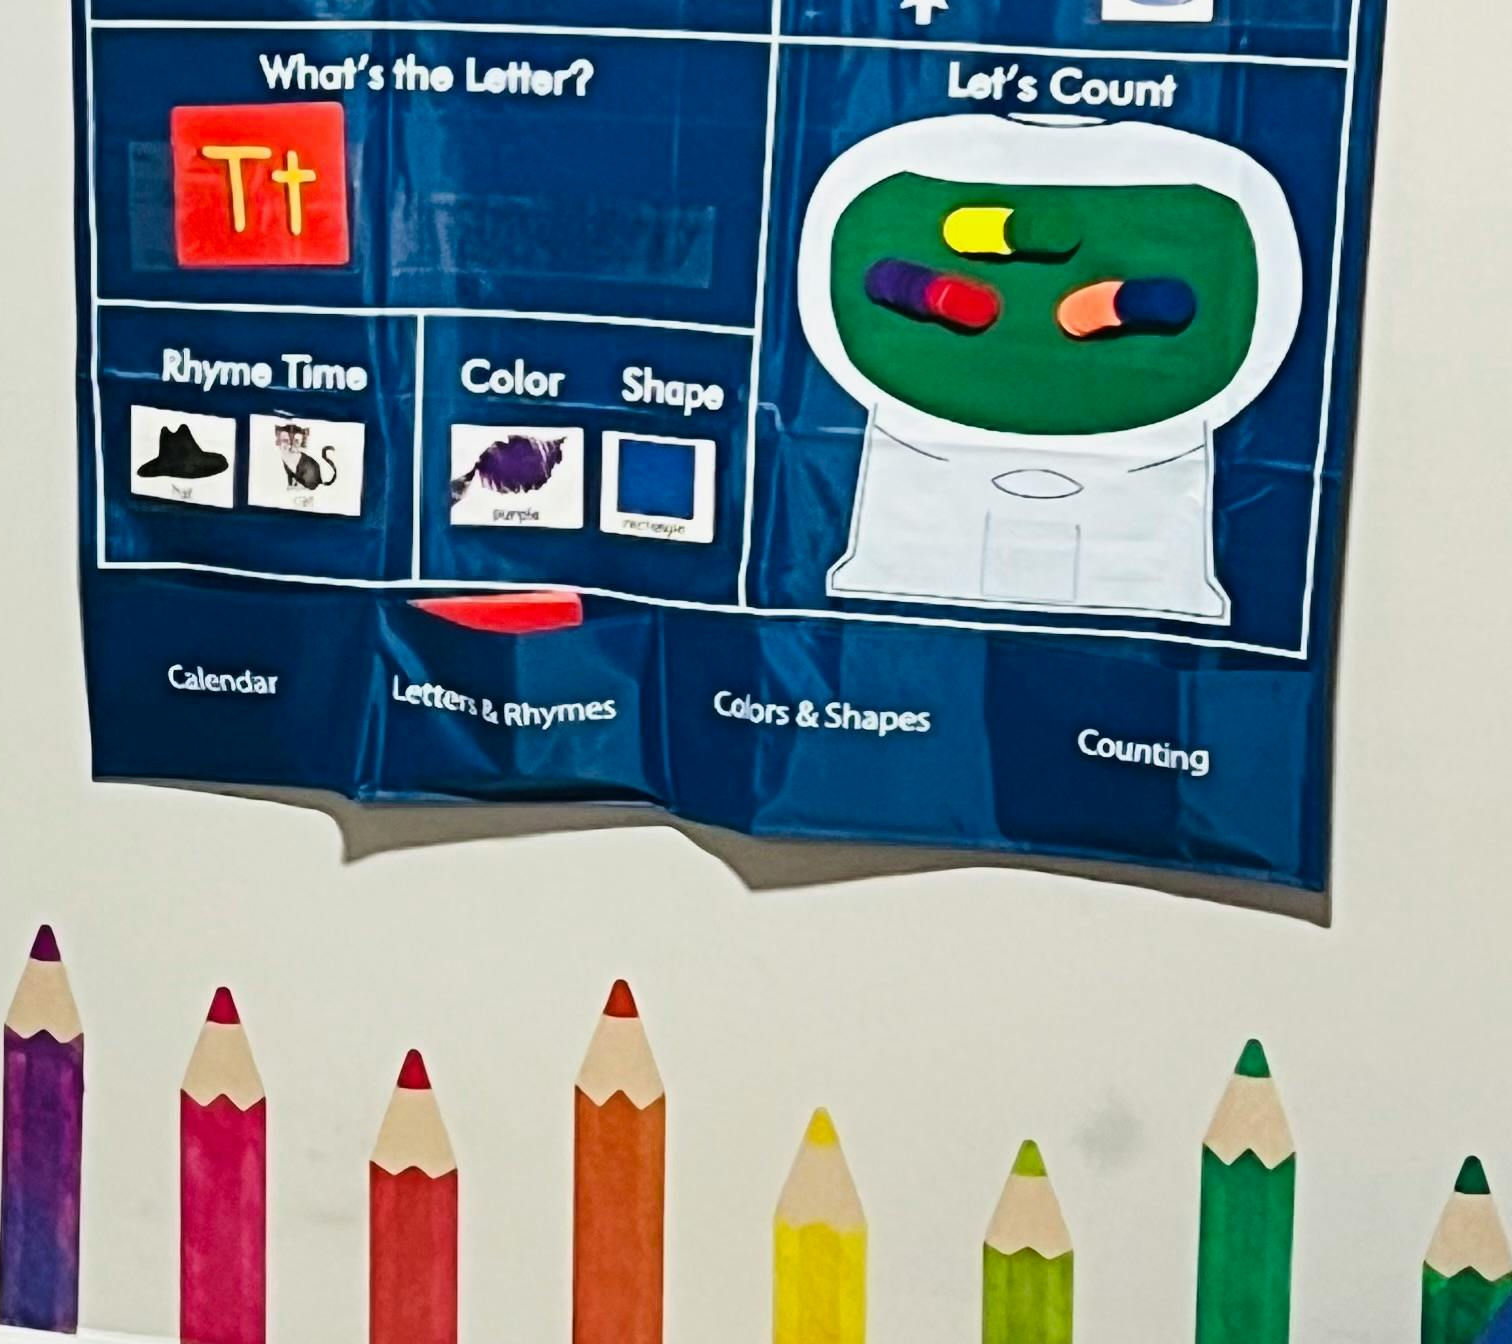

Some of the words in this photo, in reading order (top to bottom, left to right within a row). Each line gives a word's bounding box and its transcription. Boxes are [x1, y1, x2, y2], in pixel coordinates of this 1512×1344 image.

[260, 53, 385, 92] What's
[393, 55, 454, 91] the
[466, 59, 594, 97] Letter?
[948, 62, 1038, 102] Let's
[1048, 67, 1178, 109] Count
[202, 144, 317, 236] Tt
[162, 348, 274, 391] Rhyme
[282, 353, 368, 391] Time
[461, 357, 566, 398] Color
[621, 367, 725, 417] Shape
[168, 663, 278, 698] Calendar
[391, 674, 478, 716] Letters
[482, 698, 499, 724] &
[503, 699, 618, 731] Rhymes
[713, 690, 789, 727] Colors
[795, 699, 819, 729] &
[824, 701, 931, 737] Shapes
[1078, 728, 1210, 776] Counting
